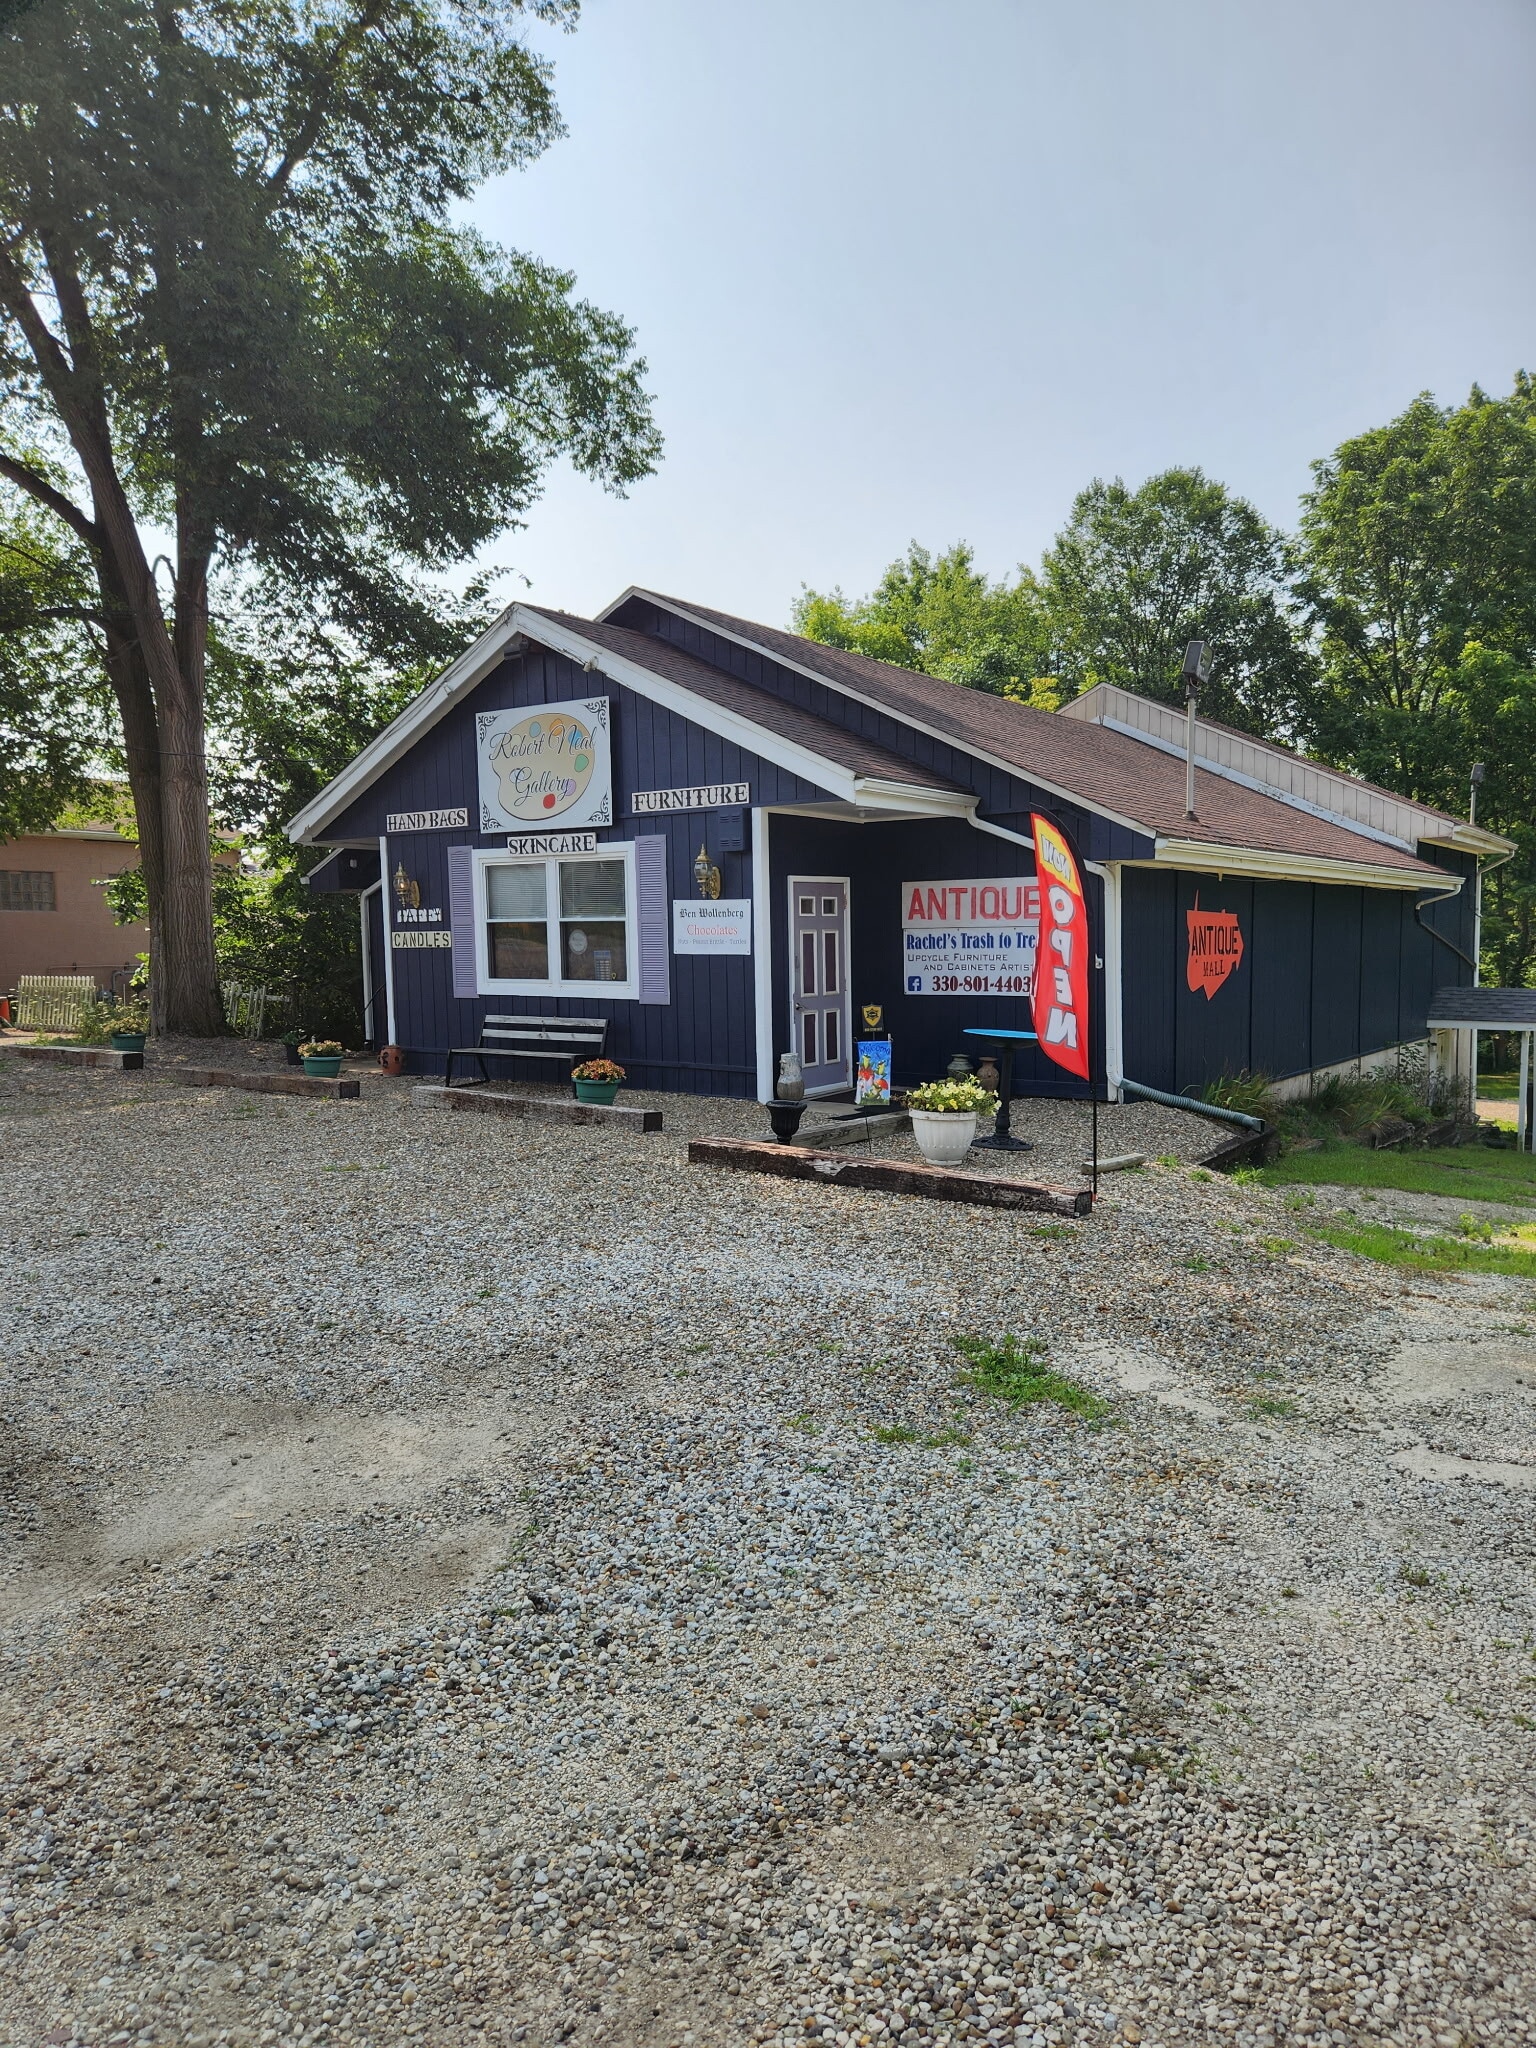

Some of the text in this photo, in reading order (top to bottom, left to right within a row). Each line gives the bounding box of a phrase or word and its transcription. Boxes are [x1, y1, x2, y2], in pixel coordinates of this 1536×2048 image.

[488, 724, 597, 760] Robert Neal
[509, 766, 571, 807] Gallery
[633, 784, 748, 812] FURNITURE
[387, 809, 466, 831] HAND BAGS
[508, 834, 594, 855] SKINCARE
[679, 907, 744, 920] Ben Wollenberg
[686, 924, 738, 936] Chocolates
[394, 932, 450, 948] CANDLES
[906, 931, 1037, 950] Rachel's Trash to Tre
[1191, 925, 1239, 956] ANTIQUE
[1000, 962, 1034, 971] ARTIS
[1203, 959, 1225, 977] MALL
[931, 975, 1032, 993] 330-801-4403
